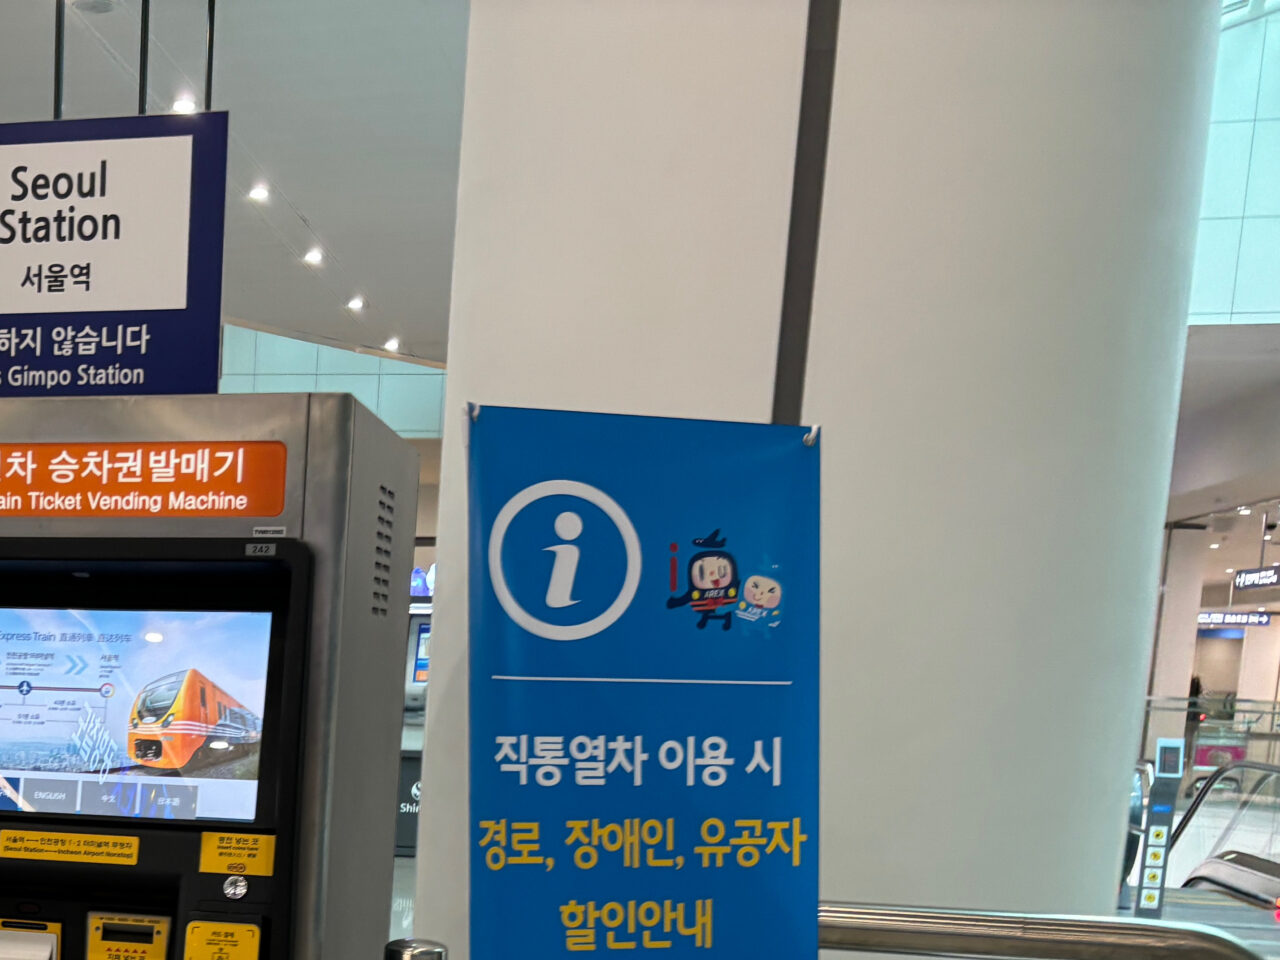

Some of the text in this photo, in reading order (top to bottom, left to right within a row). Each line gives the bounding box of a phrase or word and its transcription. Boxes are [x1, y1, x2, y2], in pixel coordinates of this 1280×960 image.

[10, 160, 108, 202] Seoul
[20, 262, 92, 294] 서울역
[51, 324, 151, 356] 않습니다
[7, 365, 71, 389] Gimpo
[77, 363, 144, 386] Station
[28, 491, 82, 511] Ticket
[87, 491, 162, 513] Vending
[168, 491, 248, 511] Machine
[33, 631, 57, 642] Train
[494, 734, 782, 787] 직통열차 이용 시
[478, 817, 808, 872] 경로, 장애인, 유공자
[559, 898, 713, 952] 할인안내
